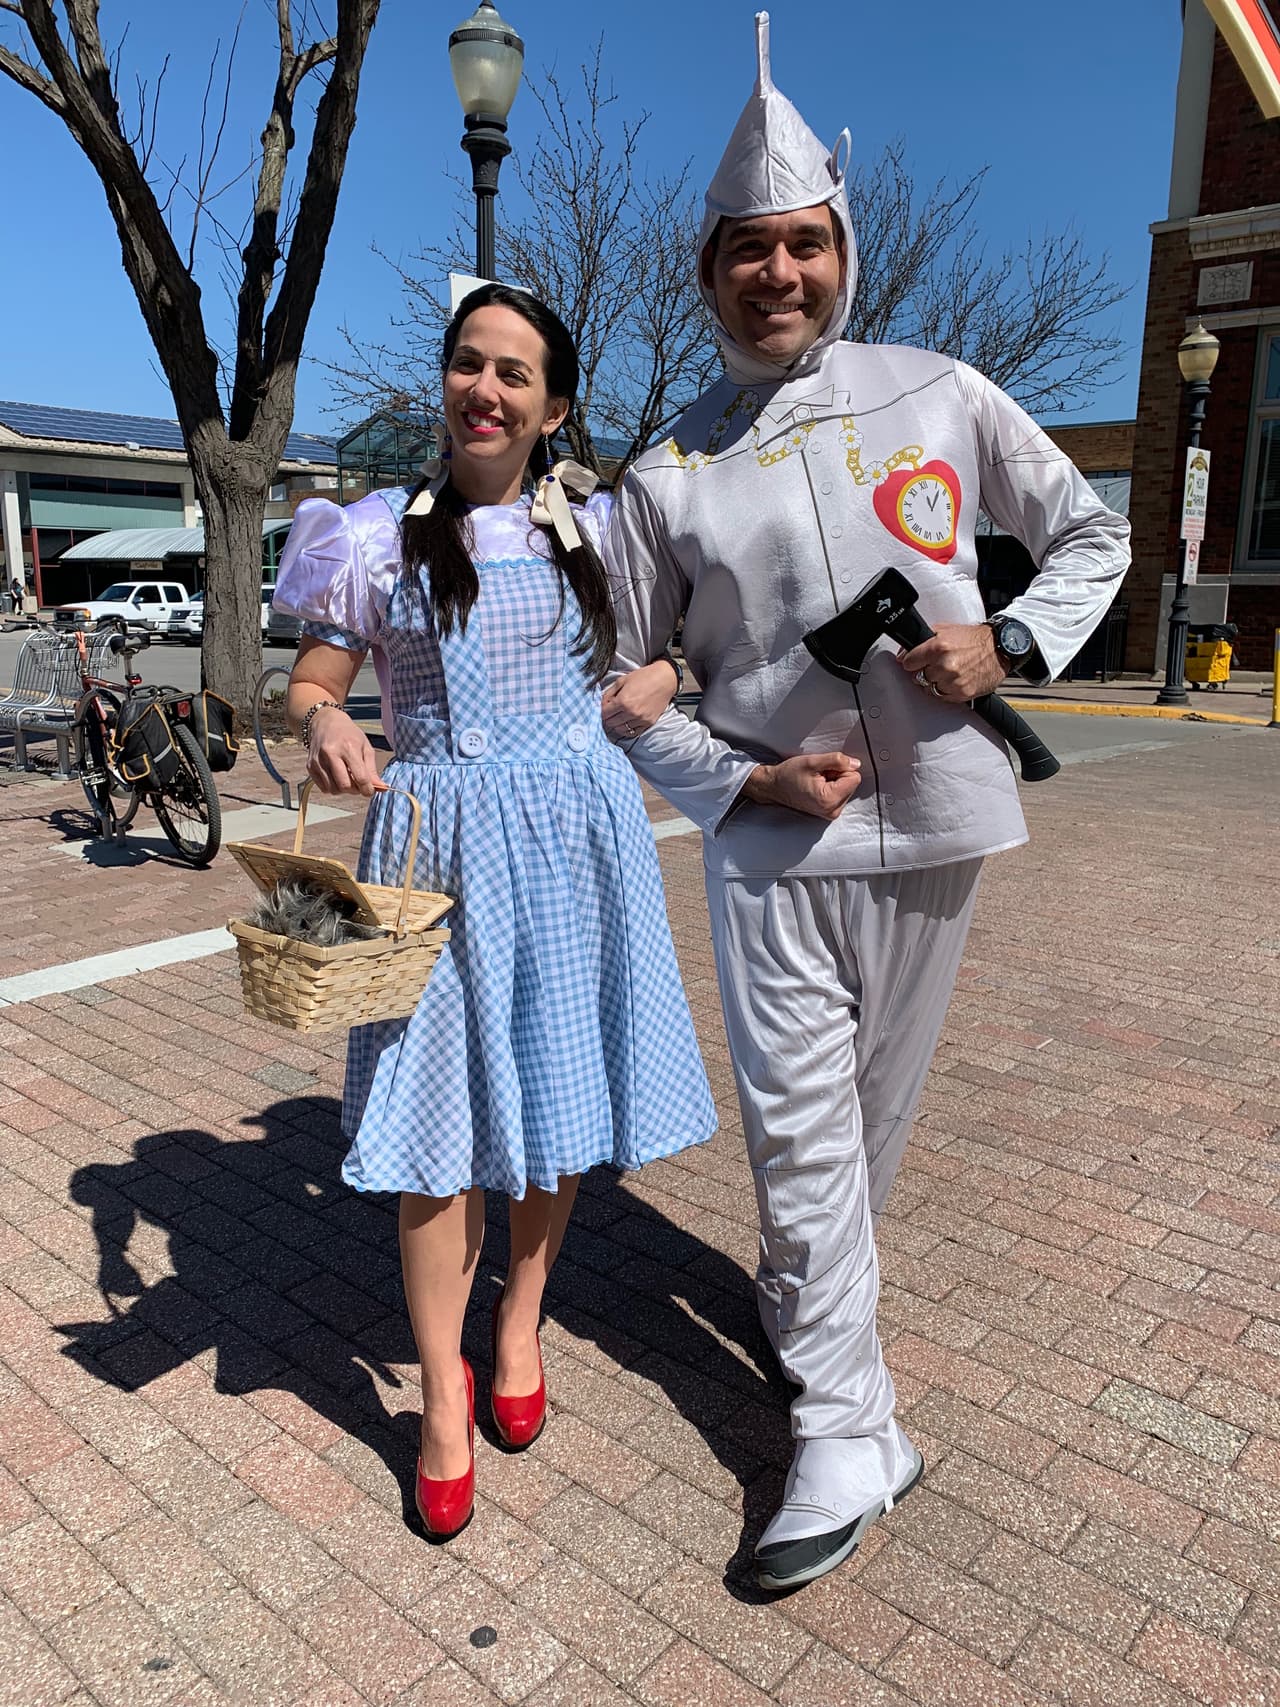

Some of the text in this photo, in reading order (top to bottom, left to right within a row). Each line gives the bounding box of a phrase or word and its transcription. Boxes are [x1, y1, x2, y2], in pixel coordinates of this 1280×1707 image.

[919, 480, 928, 490] XII
[908, 488, 917, 498] XI
[903, 500, 912, 508] X
[904, 513, 914, 522] IX
[936, 531, 944, 541] VI
